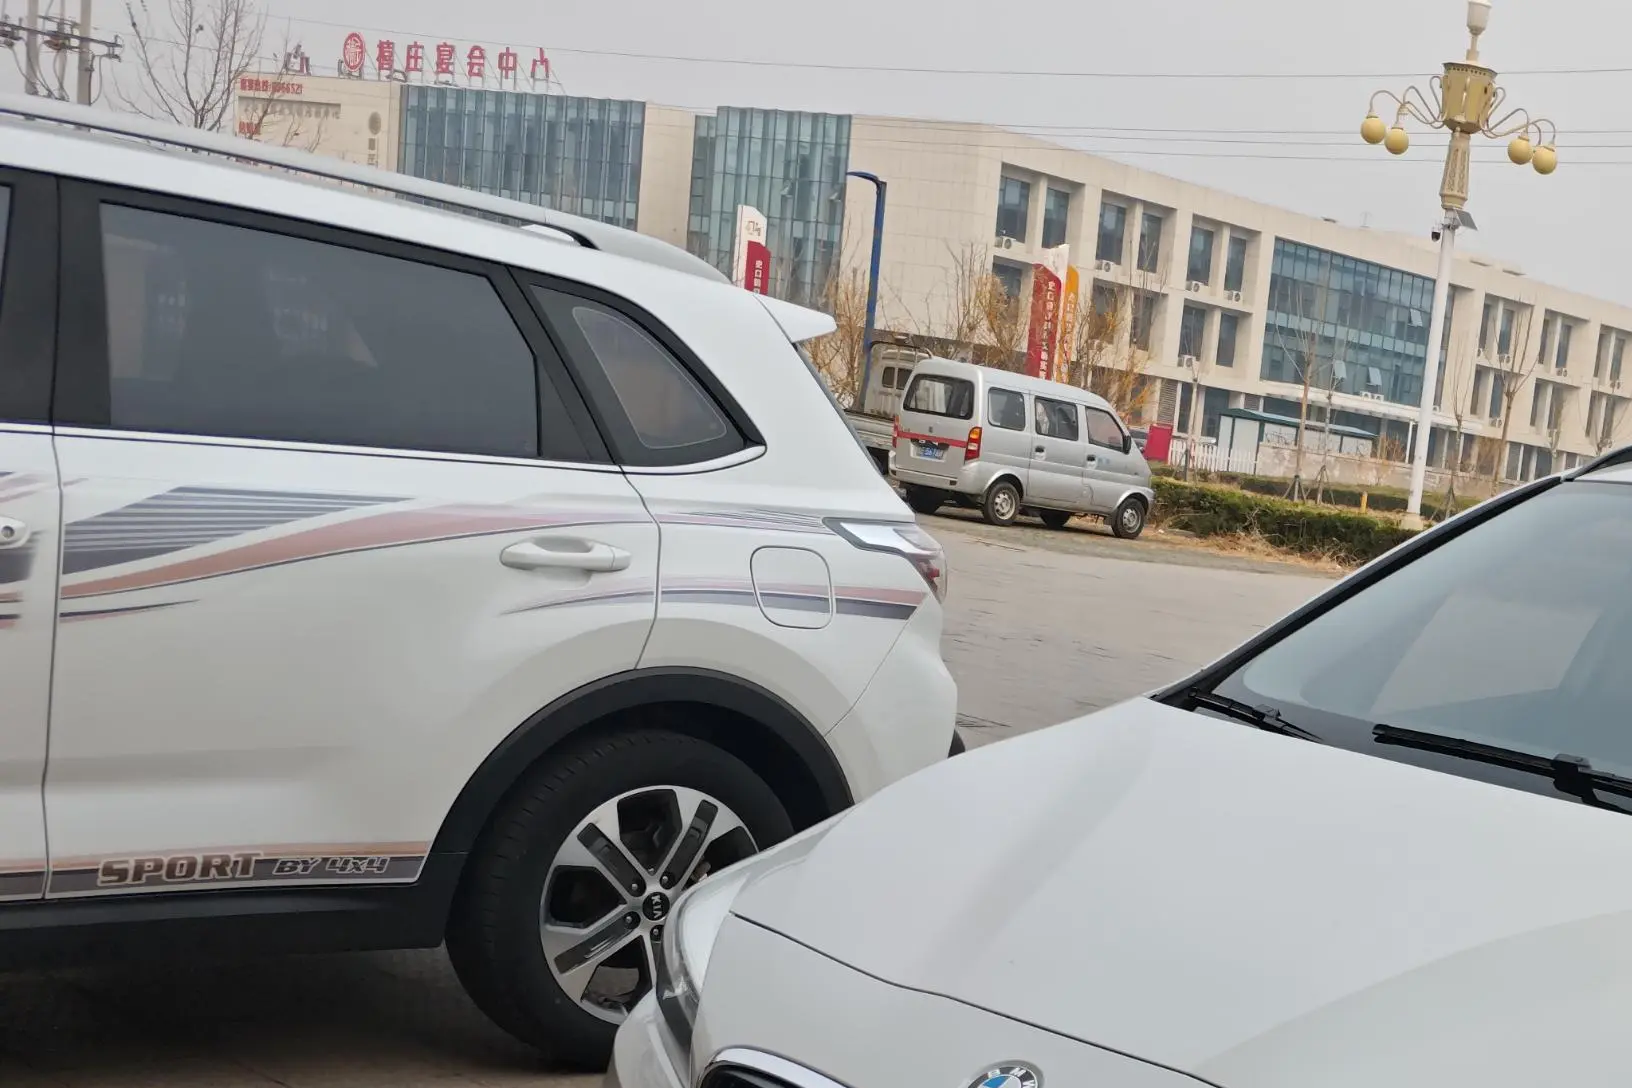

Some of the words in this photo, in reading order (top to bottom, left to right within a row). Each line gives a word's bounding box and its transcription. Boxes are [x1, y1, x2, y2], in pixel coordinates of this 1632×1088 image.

[97, 851, 262, 886] SPORT
[272, 857, 321, 876] BY
[651, 894, 663, 919] KIA
